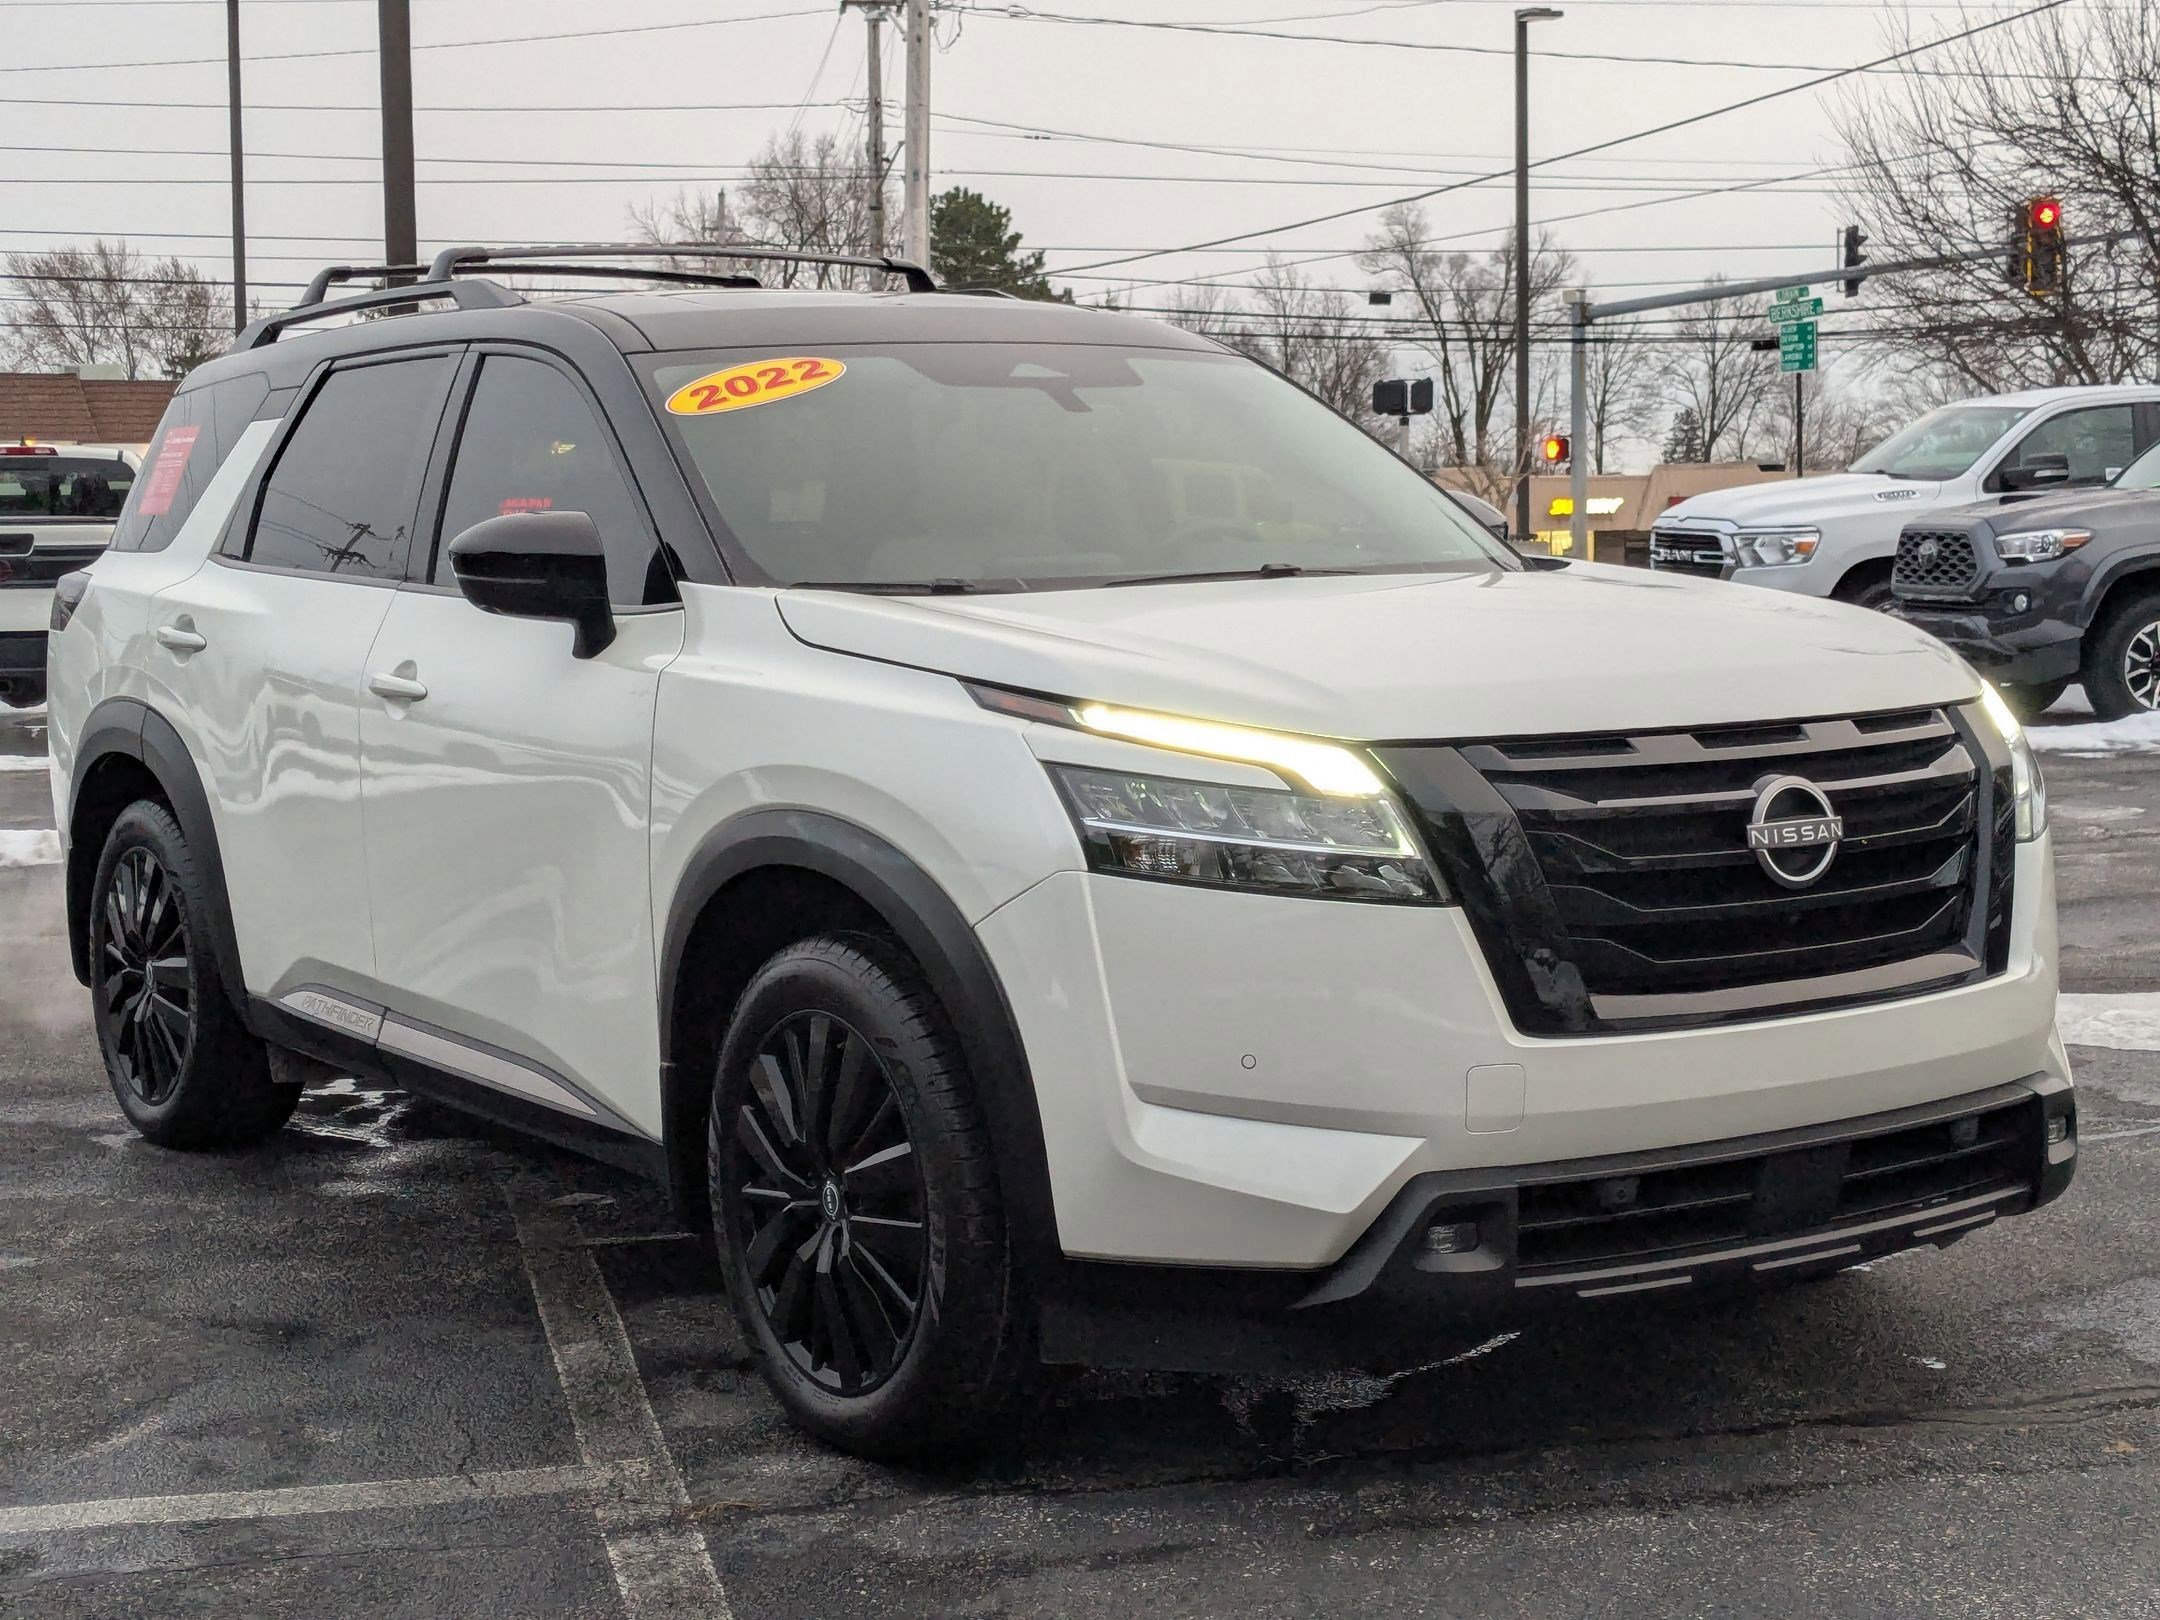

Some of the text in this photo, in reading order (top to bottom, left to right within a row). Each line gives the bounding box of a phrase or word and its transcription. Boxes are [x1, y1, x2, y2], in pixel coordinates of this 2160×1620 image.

[690, 360, 831, 410] 2022
[1751, 823, 1842, 845] NISSAN
[302, 995, 374, 1031] PATHFINDER
